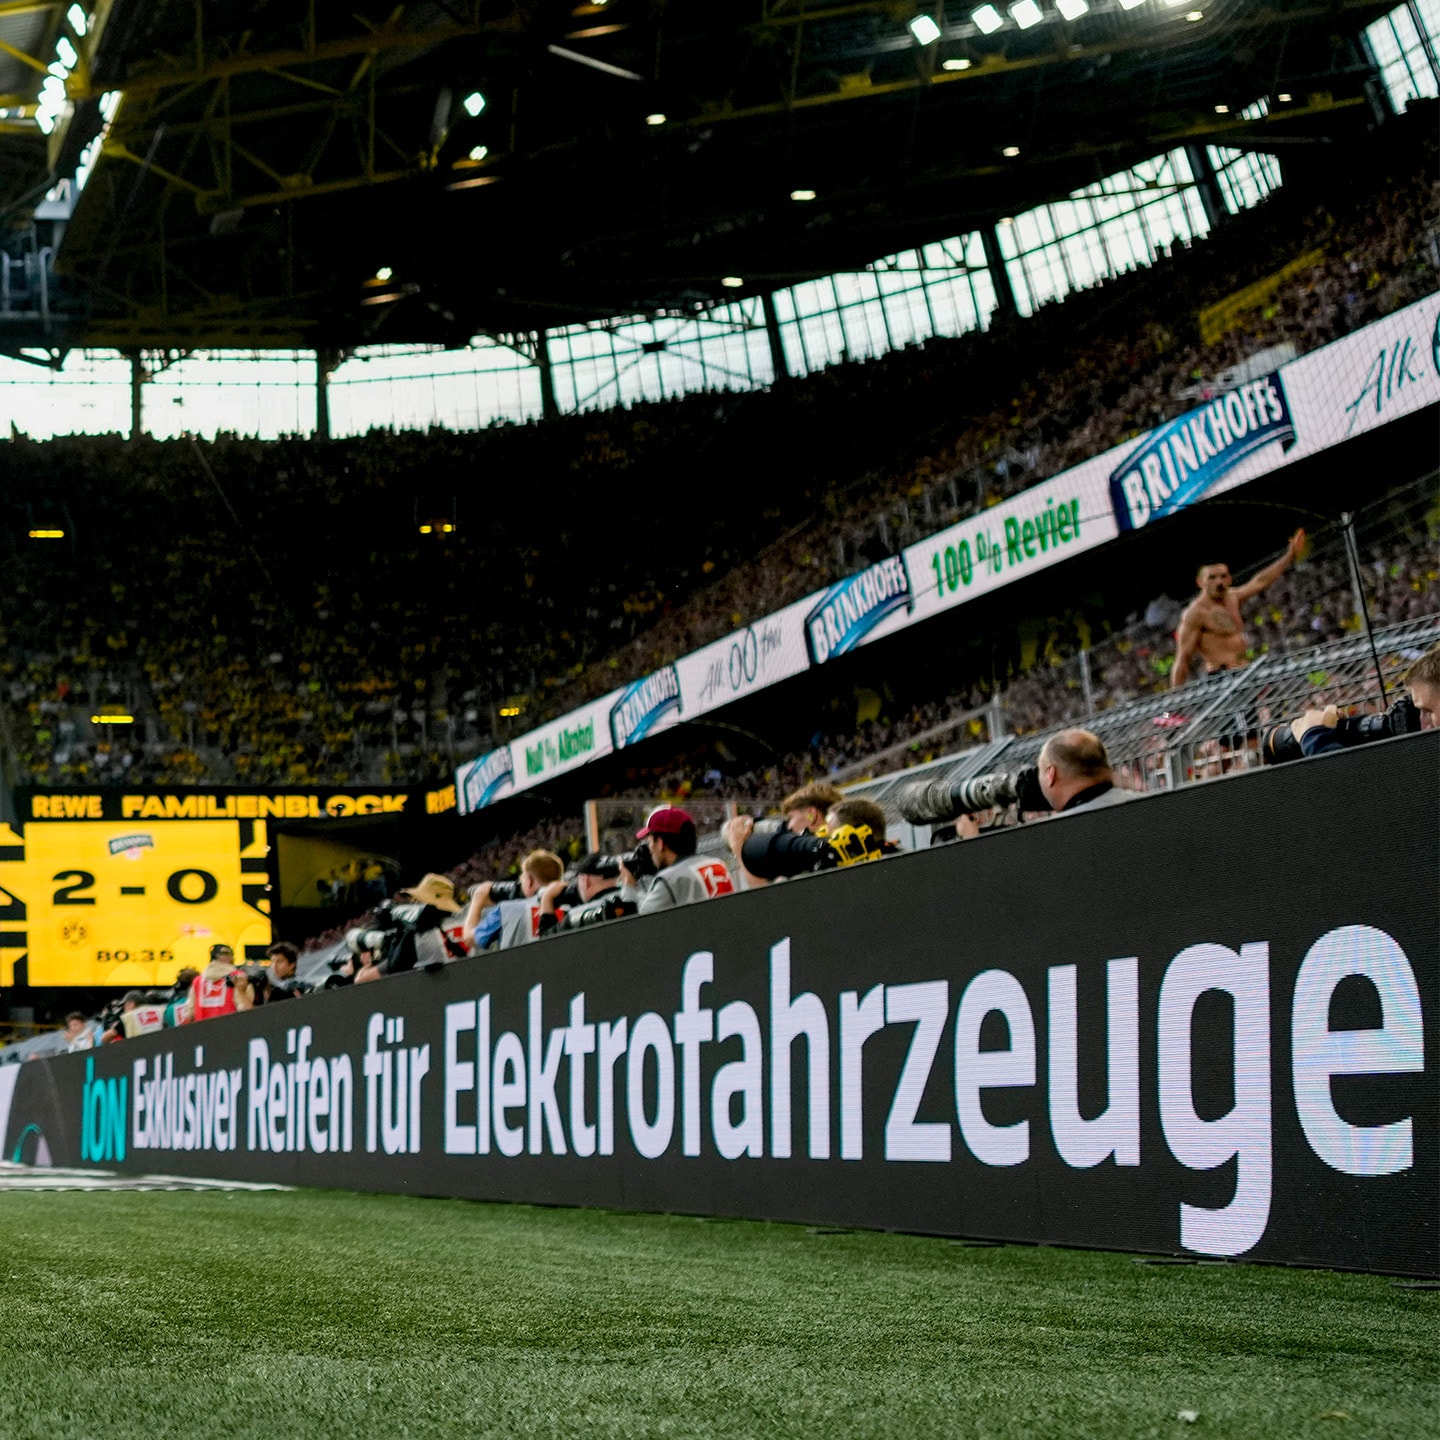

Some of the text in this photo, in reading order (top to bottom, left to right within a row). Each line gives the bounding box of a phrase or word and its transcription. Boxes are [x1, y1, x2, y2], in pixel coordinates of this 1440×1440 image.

[931, 496, 1082, 598] 100 % Revier
[32, 794, 409, 819] REWE FAMILIENBLOCK
[52, 870, 97, 906] 2
[166, 868, 219, 905] 0
[133, 1045, 243, 1152] Exklusiver
[247, 1025, 353, 1155] Reifen
[363, 1012, 431, 1155] für
[444, 923, 1425, 1257] Elektrofahrzeuge
